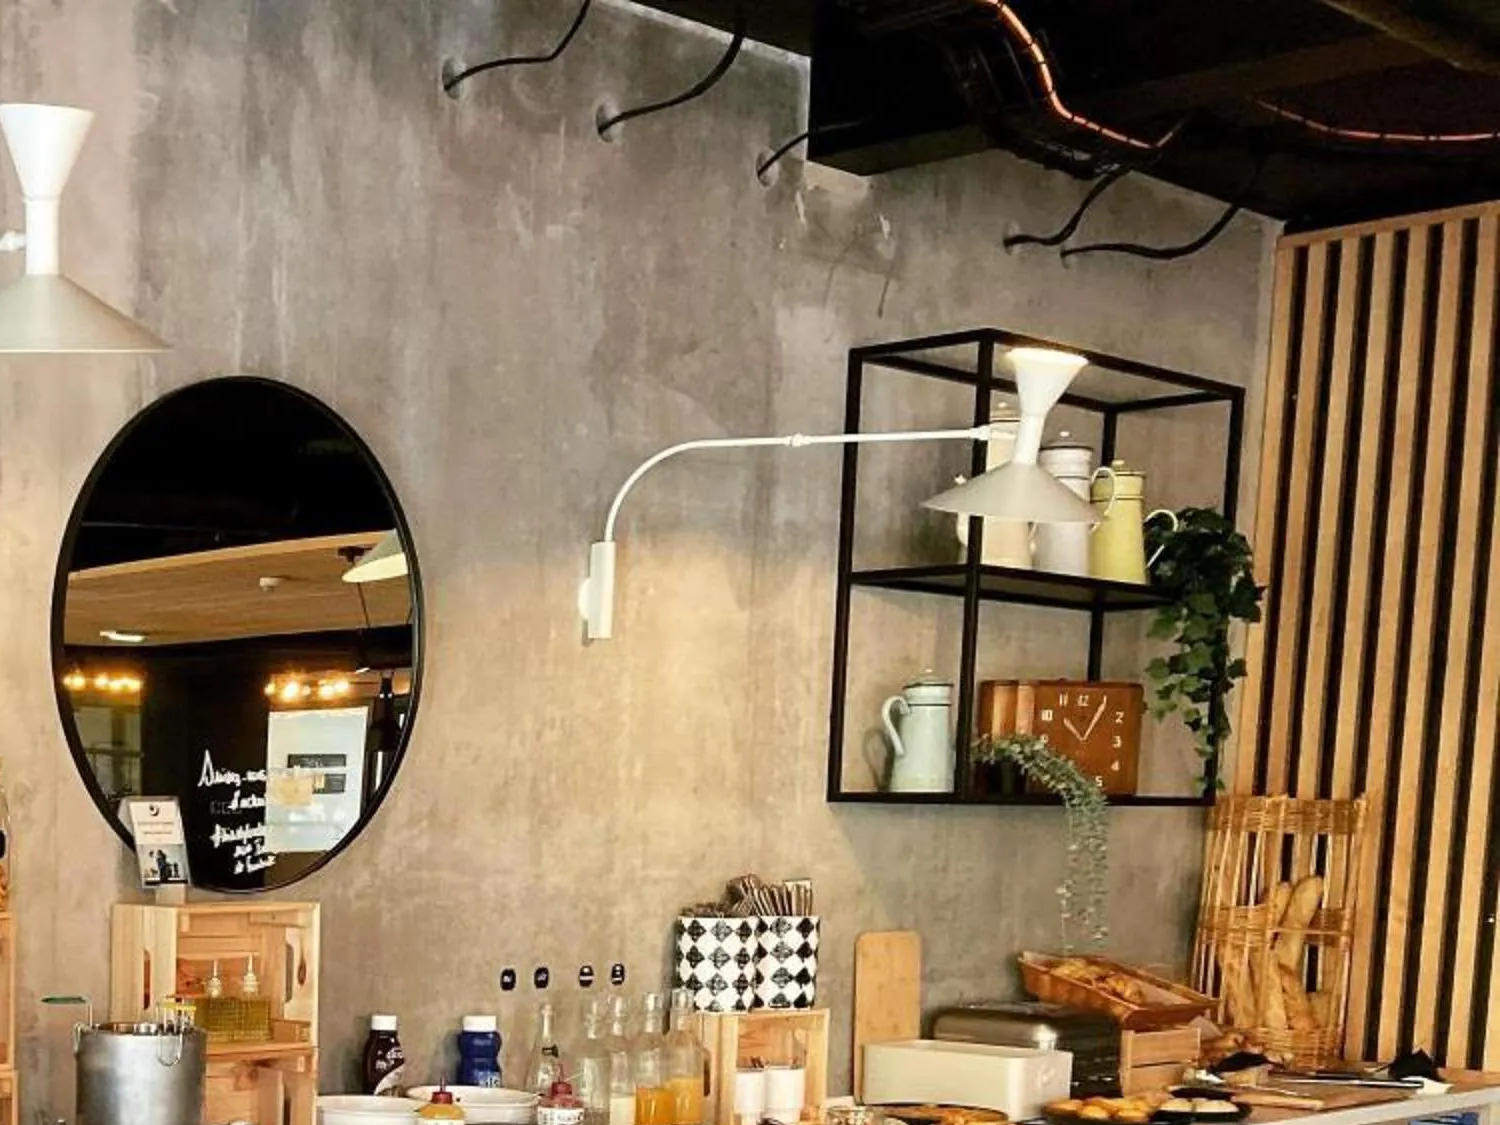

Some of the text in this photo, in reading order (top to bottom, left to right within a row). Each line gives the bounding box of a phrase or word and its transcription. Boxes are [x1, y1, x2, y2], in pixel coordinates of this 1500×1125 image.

[1041, 709, 1053, 721] 10
[1115, 711, 1124, 723] 2
[1112, 736, 1122, 748] 3
[1095, 775, 1104, 787] 5
